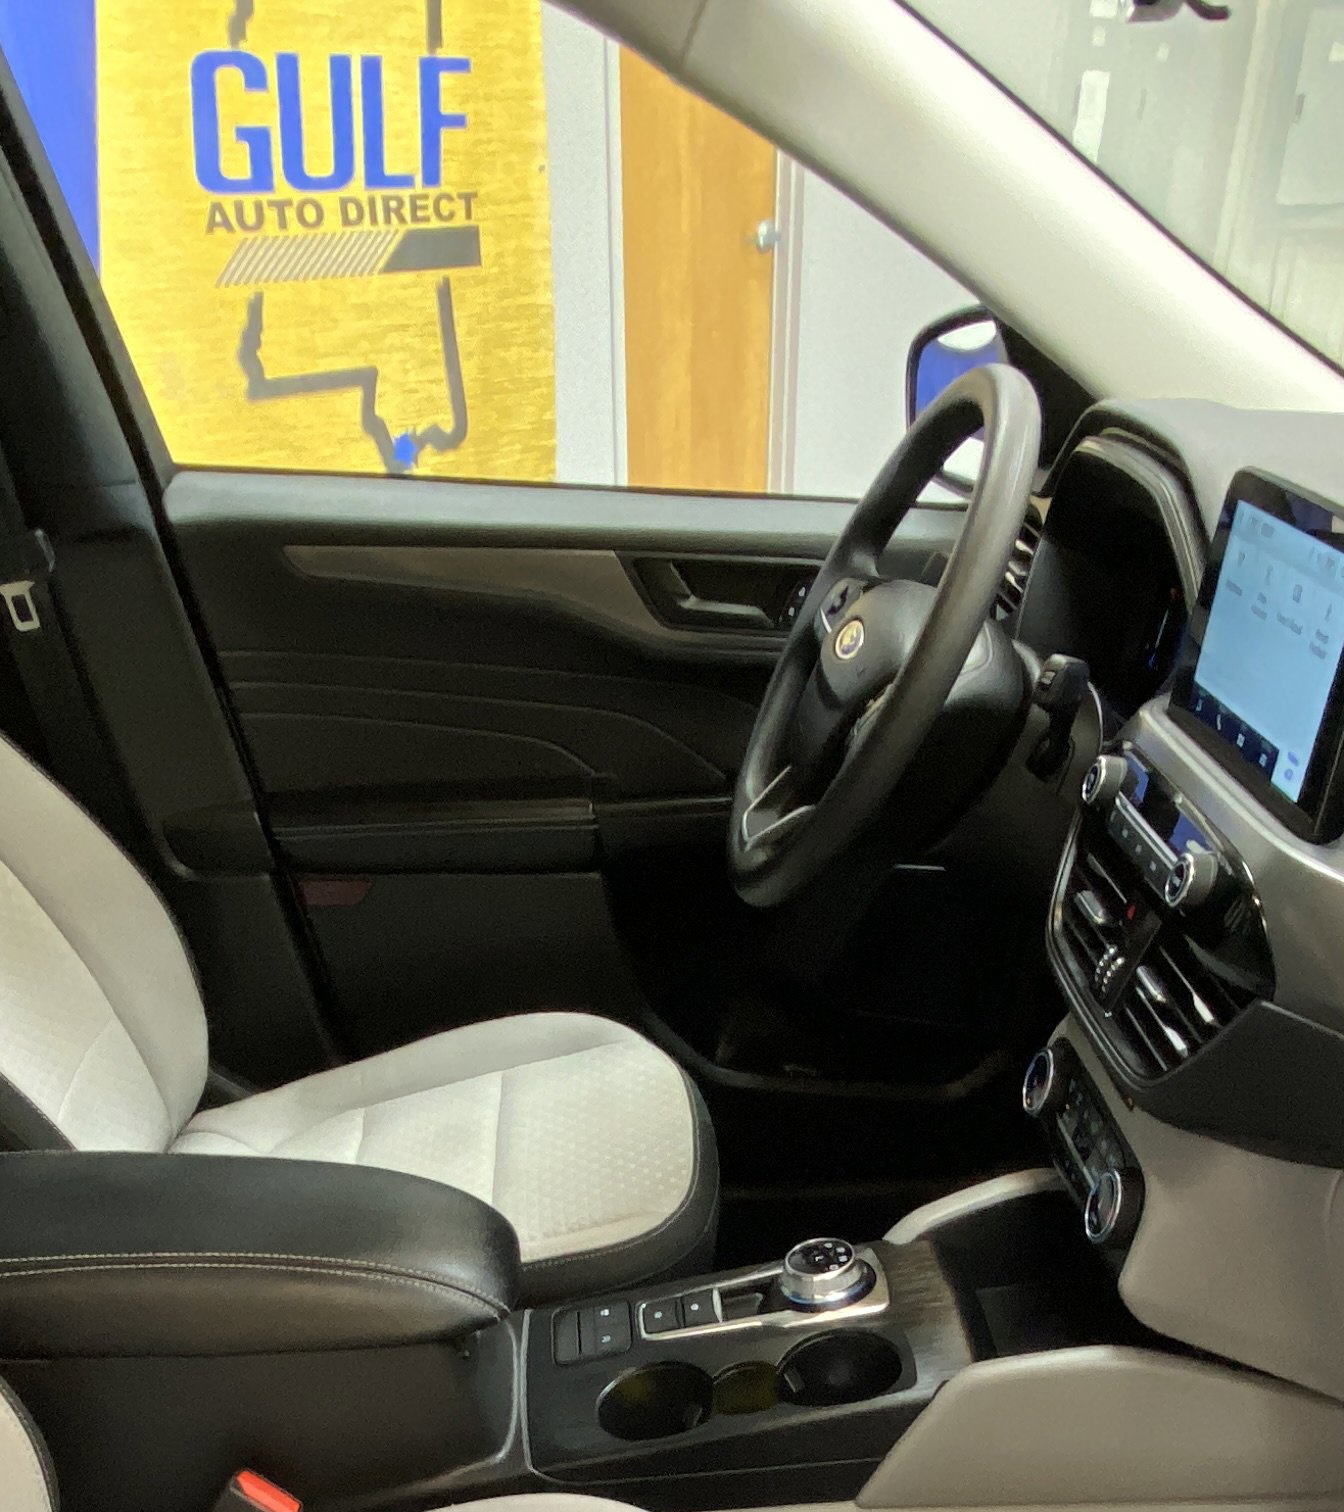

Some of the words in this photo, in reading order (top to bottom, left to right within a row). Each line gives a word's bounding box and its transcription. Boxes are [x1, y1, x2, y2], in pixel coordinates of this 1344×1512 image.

[190, 49, 472, 194] GULF
[205, 197, 325, 235] AUTO
[338, 191, 479, 228] DIRECT
